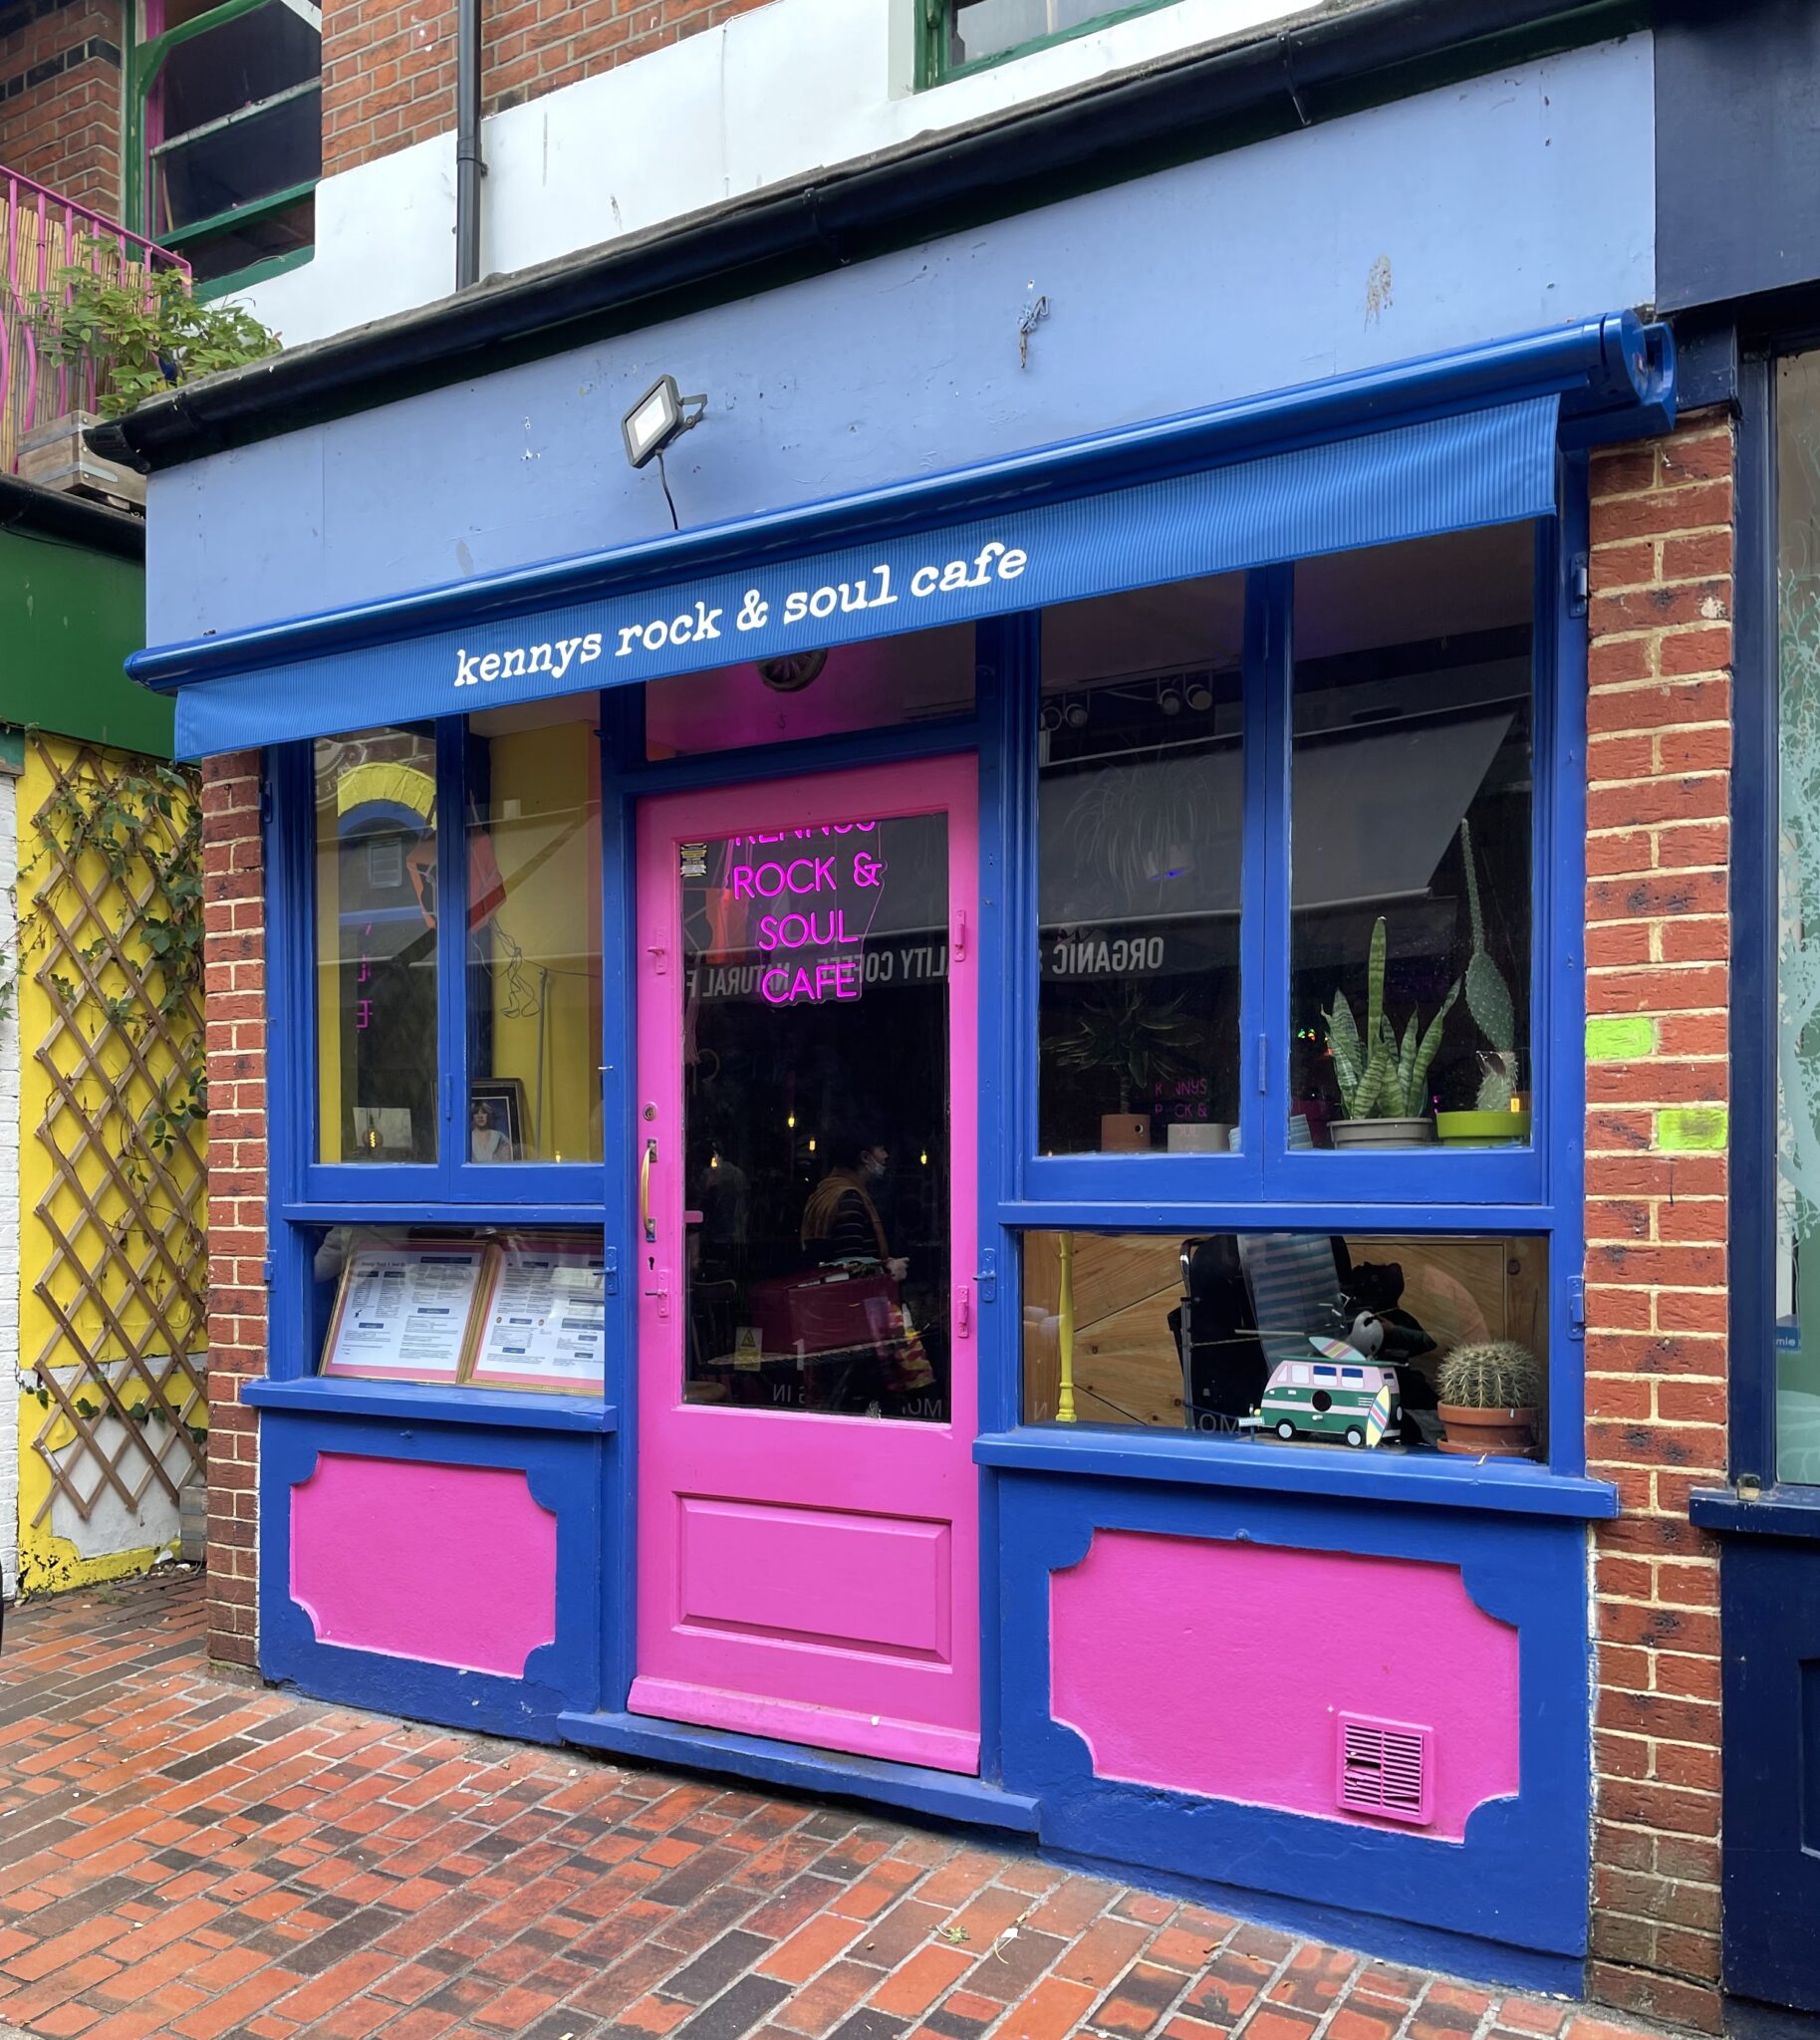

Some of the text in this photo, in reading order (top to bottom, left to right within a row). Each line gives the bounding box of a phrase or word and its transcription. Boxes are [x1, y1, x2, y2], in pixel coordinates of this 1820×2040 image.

[453, 542, 1028, 687] kennys rock & soul cafe
[733, 856, 837, 900] ROCK
[853, 852, 883, 888] &
[758, 909, 860, 951] SOUL
[761, 962, 858, 1003] CAFE
